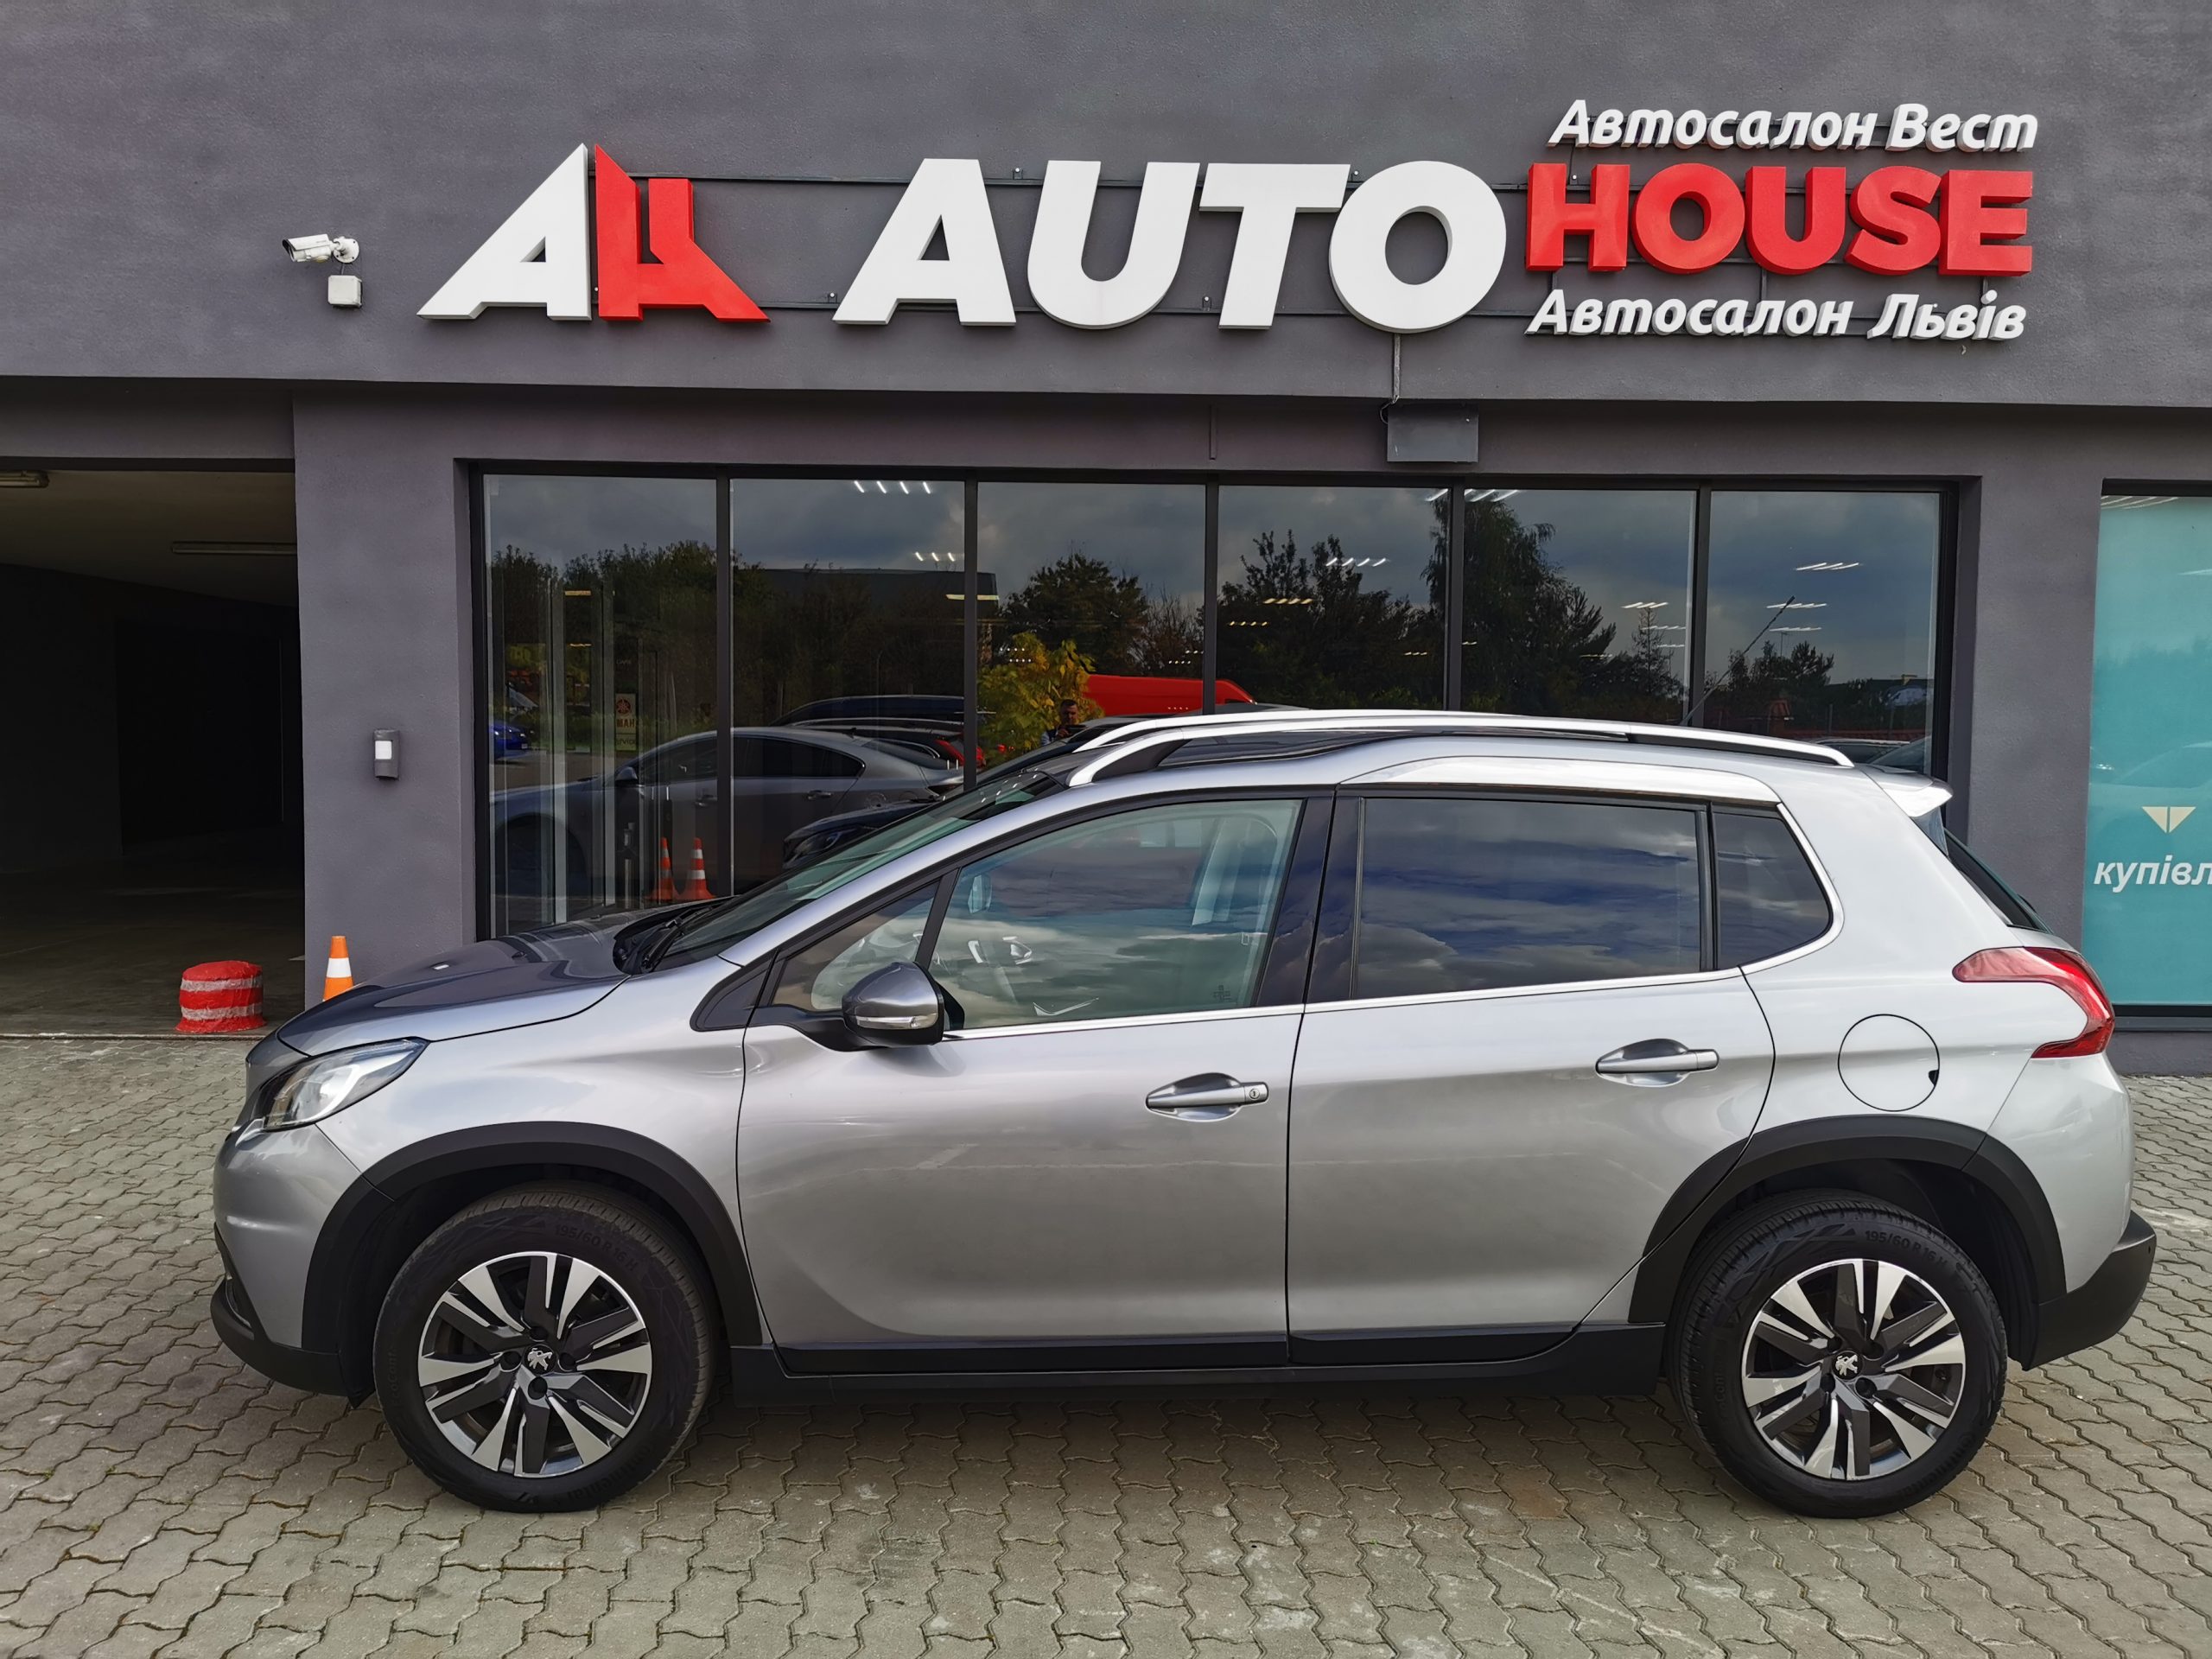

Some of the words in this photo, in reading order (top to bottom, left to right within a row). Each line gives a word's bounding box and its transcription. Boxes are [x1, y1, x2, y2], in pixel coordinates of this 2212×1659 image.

[1548, 99, 1879, 149] Автосалон
[1887, 103, 2038, 150] Вест
[832, 157, 1507, 330] AUTO
[1526, 162, 2034, 276] HOUSE
[1525, 289, 1855, 336] Автосалон
[1868, 289, 2027, 340] Львів
[555, 1224, 601, 1247] 195/60
[1865, 1230, 1910, 1249] 195/60
[1923, 1247, 1937, 1262] 16
